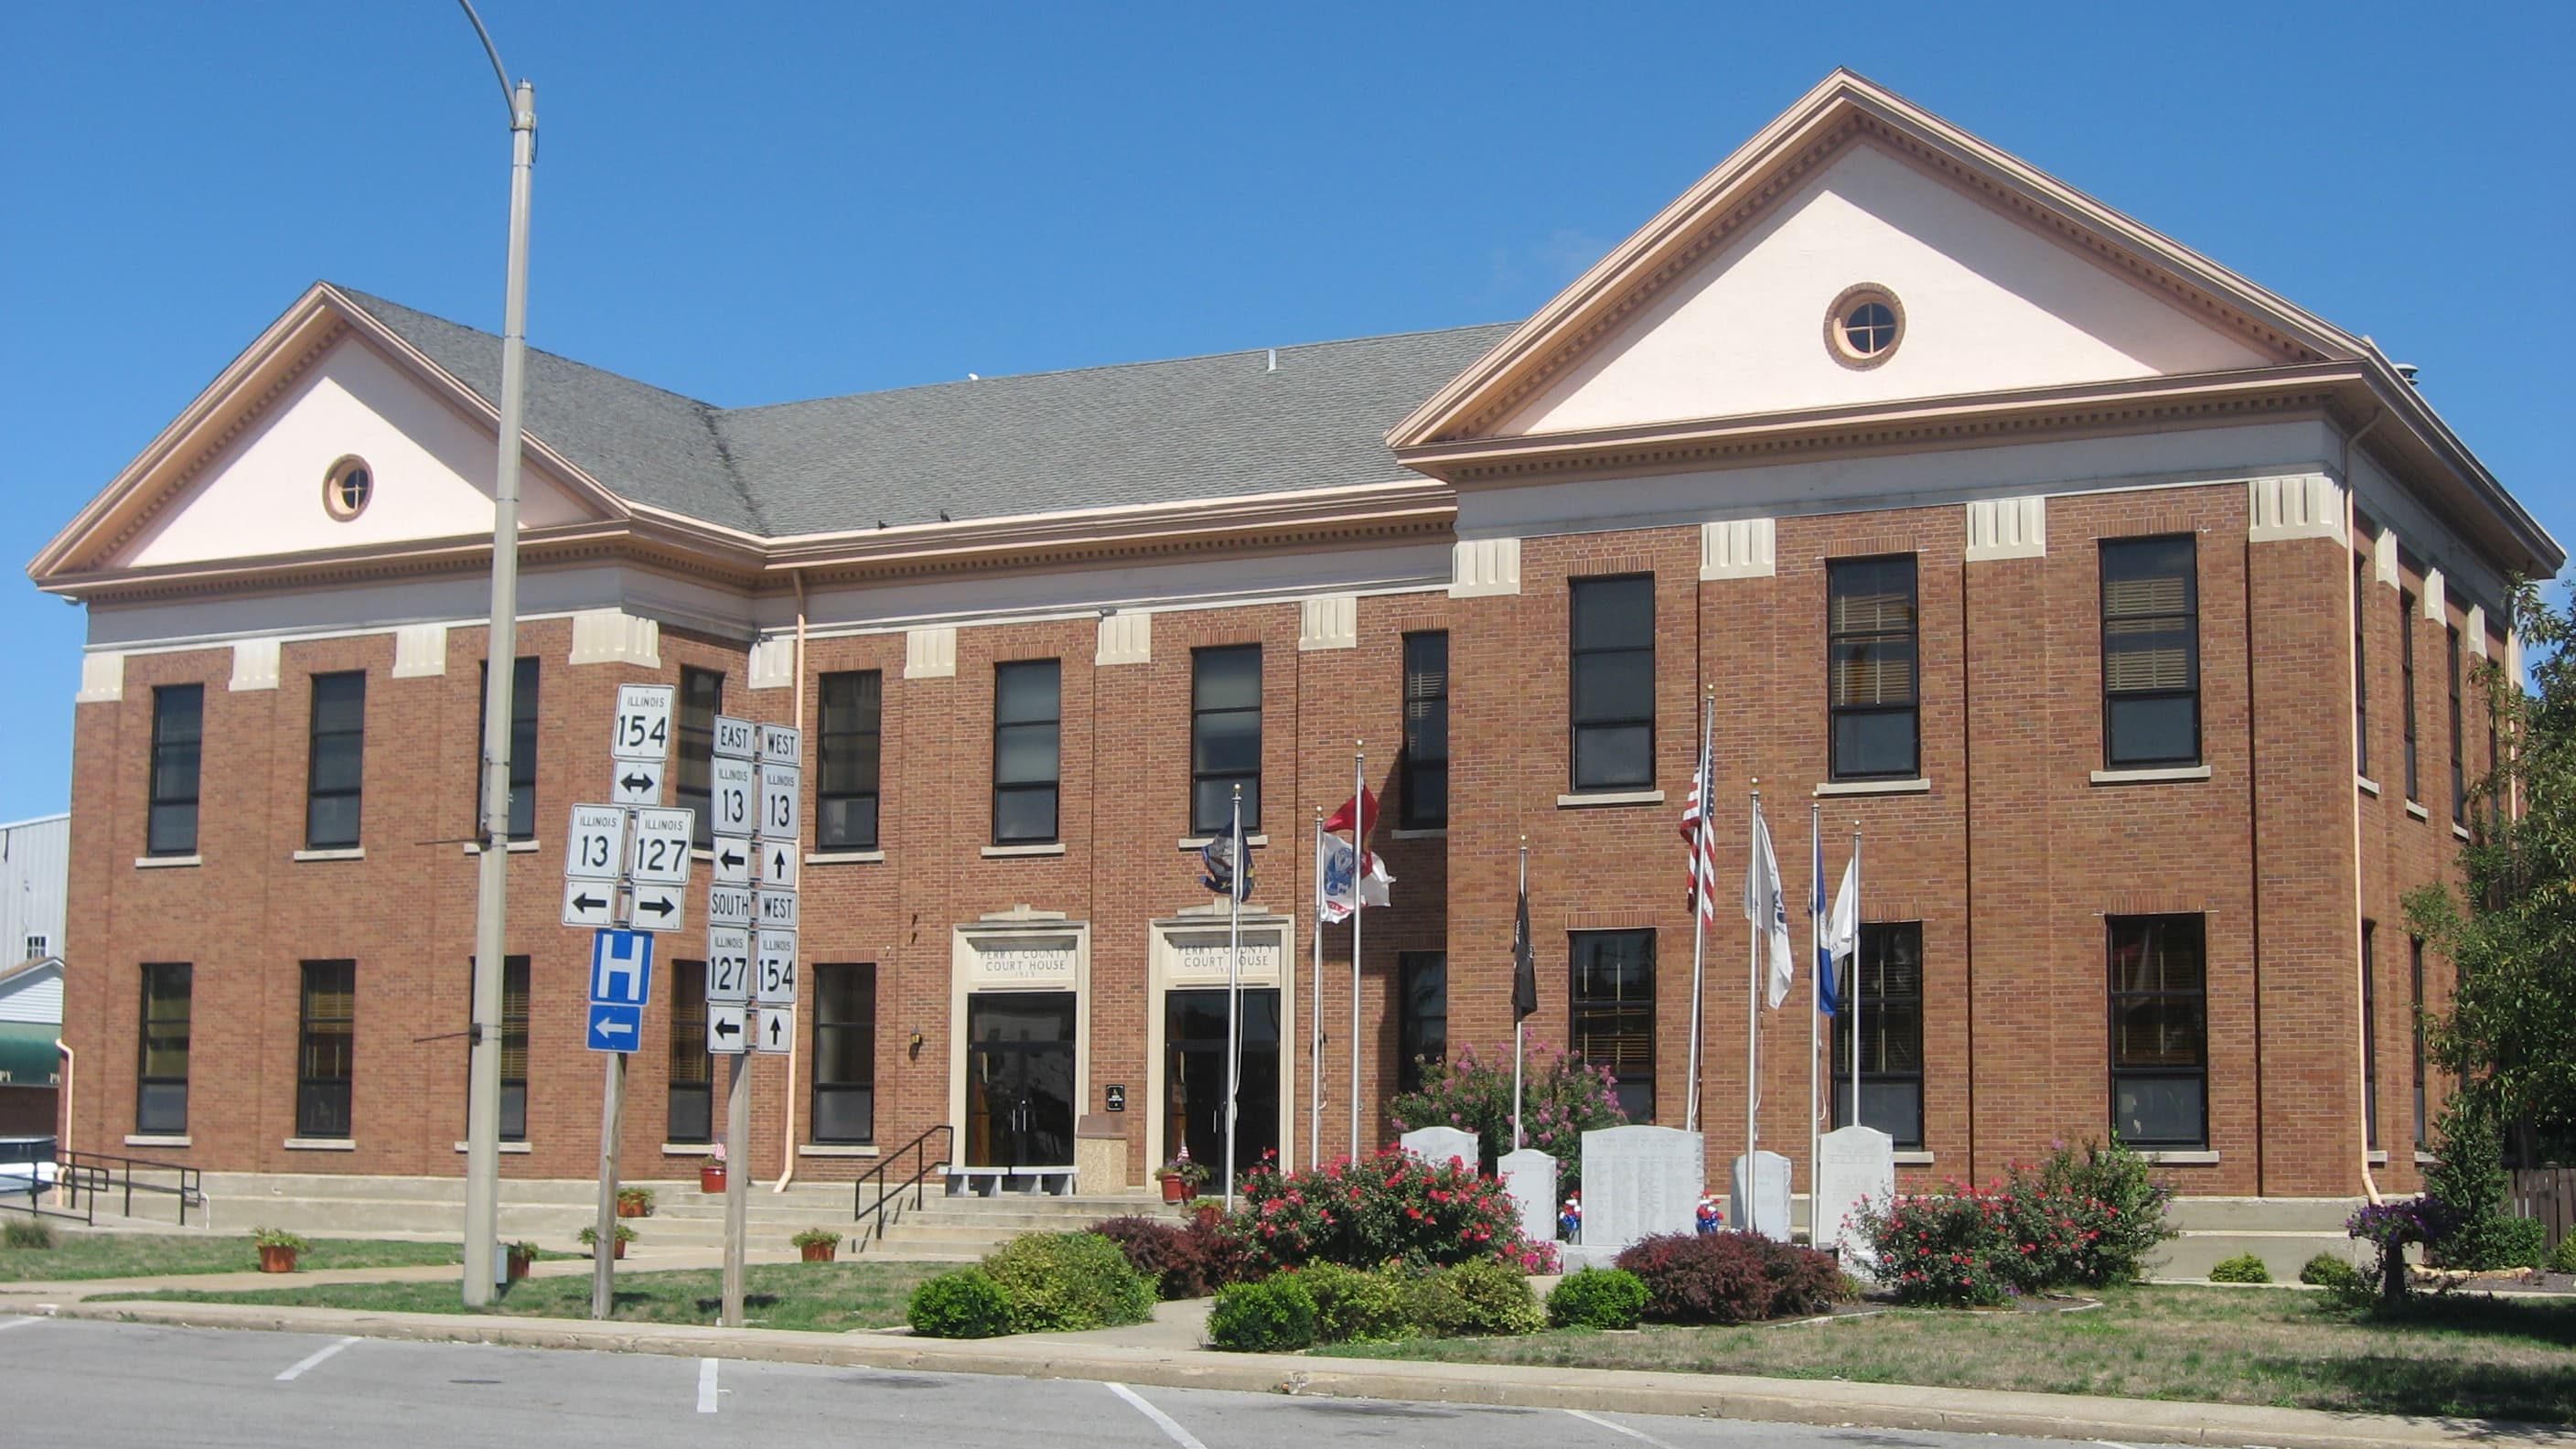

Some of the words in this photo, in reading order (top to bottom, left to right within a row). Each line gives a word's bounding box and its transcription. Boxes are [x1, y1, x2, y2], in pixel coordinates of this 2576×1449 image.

[628, 695, 666, 708] ILLINOIS
[618, 714, 666, 748] 154
[720, 725, 748, 749] EAST
[767, 731, 796, 757] WEST
[718, 768, 748, 782] ILLINOIS
[767, 774, 795, 788] ILLINOIS
[723, 789, 744, 823] 13
[770, 793, 790, 828] 13
[579, 815, 617, 828] ILLINOIS
[644, 819, 684, 832] ILLINOIS
[582, 834, 609, 867] 13
[638, 837, 688, 872] 127
[711, 893, 749, 916] SOUTH
[763, 896, 793, 919] WEST
[714, 936, 744, 949] ILLINOIS
[763, 939, 791, 951] ILLINOIS
[980, 950, 1014, 960] PERRY
[1022, 948, 1070, 960] COUNTY
[1177, 945, 1213, 956] PERRY
[1222, 943, 1273, 954] CUNTY
[596, 933, 645, 1002] H
[985, 961, 1023, 971] COURT
[1029, 960, 1066, 971] HOUSE
[1184, 956, 1224, 968] COURT
[1235, 955, 1269, 967] OUSE
[710, 956, 747, 991] 127
[758, 958, 794, 993] 154
